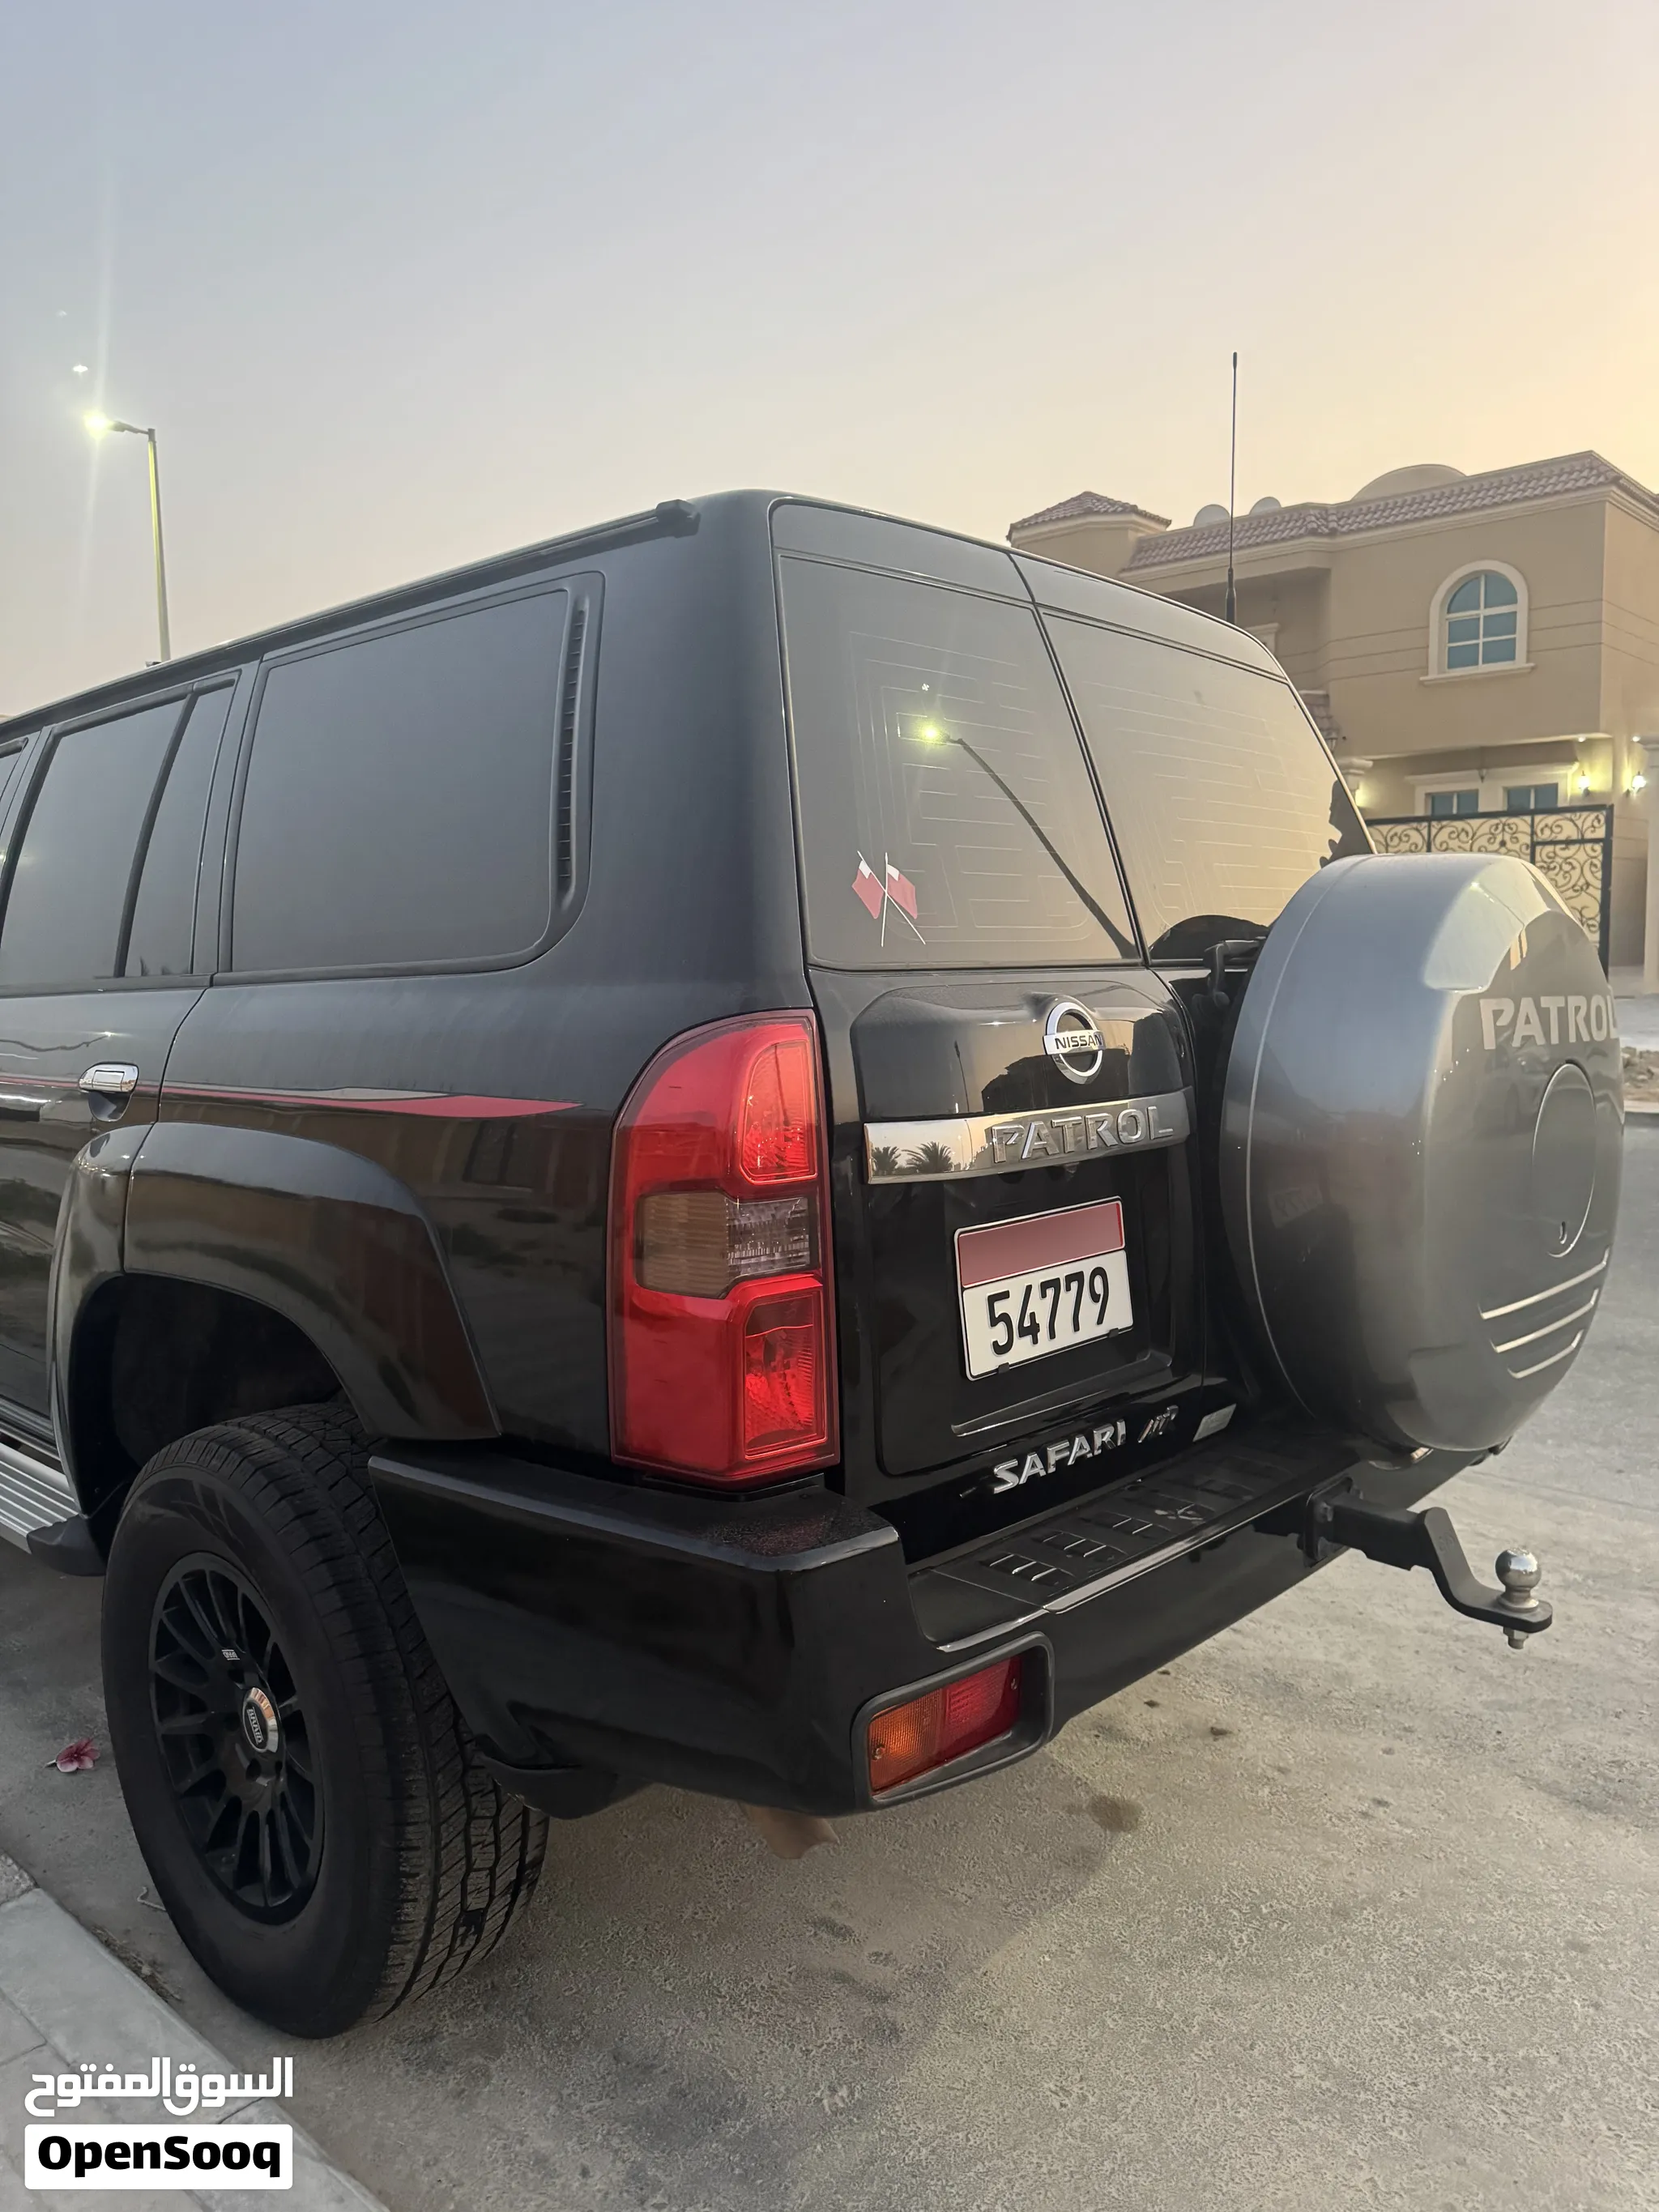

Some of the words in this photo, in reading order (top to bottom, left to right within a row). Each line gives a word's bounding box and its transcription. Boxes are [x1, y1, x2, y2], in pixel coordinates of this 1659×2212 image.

[1055, 1032, 1102, 1050] NISSAN
[1479, 995, 1619, 1050] PATROL
[992, 1106, 1174, 1163] PATROL
[987, 1266, 1110, 1355] 54779
[993, 1419, 1127, 1494] SAFARI
